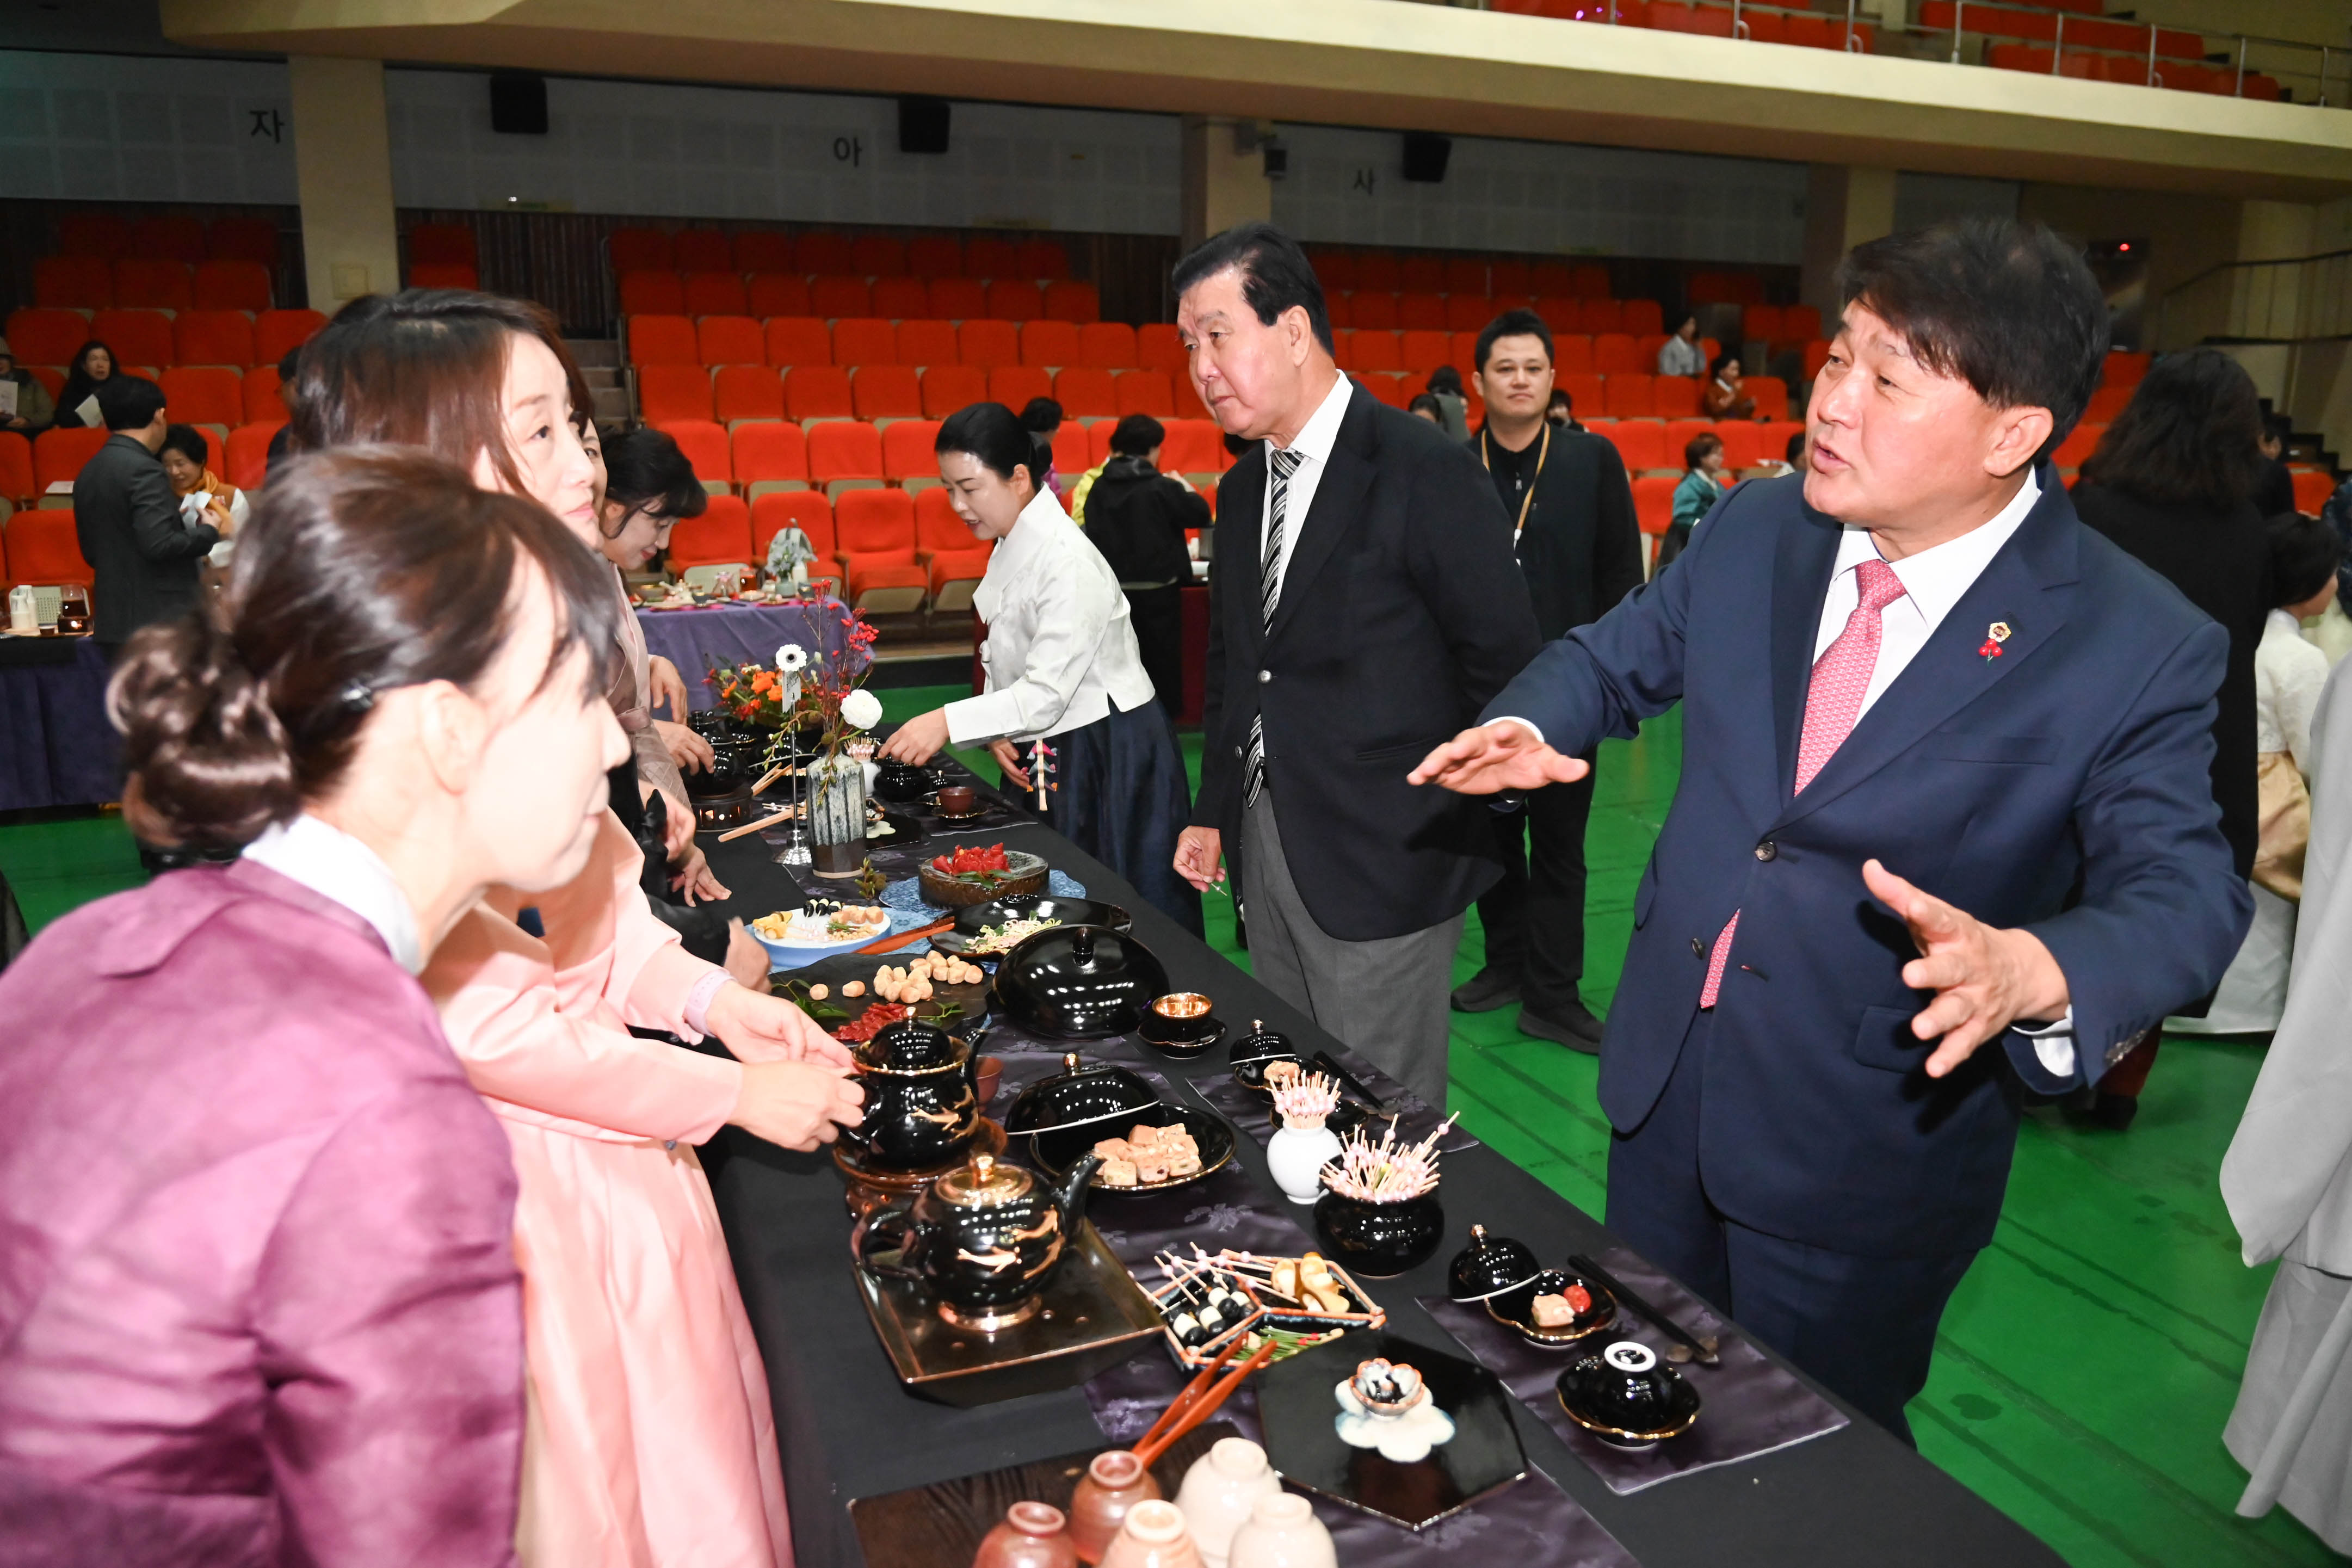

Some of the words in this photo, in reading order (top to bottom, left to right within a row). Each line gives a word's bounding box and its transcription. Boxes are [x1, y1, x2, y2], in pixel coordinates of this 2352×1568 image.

[249, 108, 285, 144] 자
[833, 135, 863, 167] 아
[1353, 166, 1378, 195] 사
